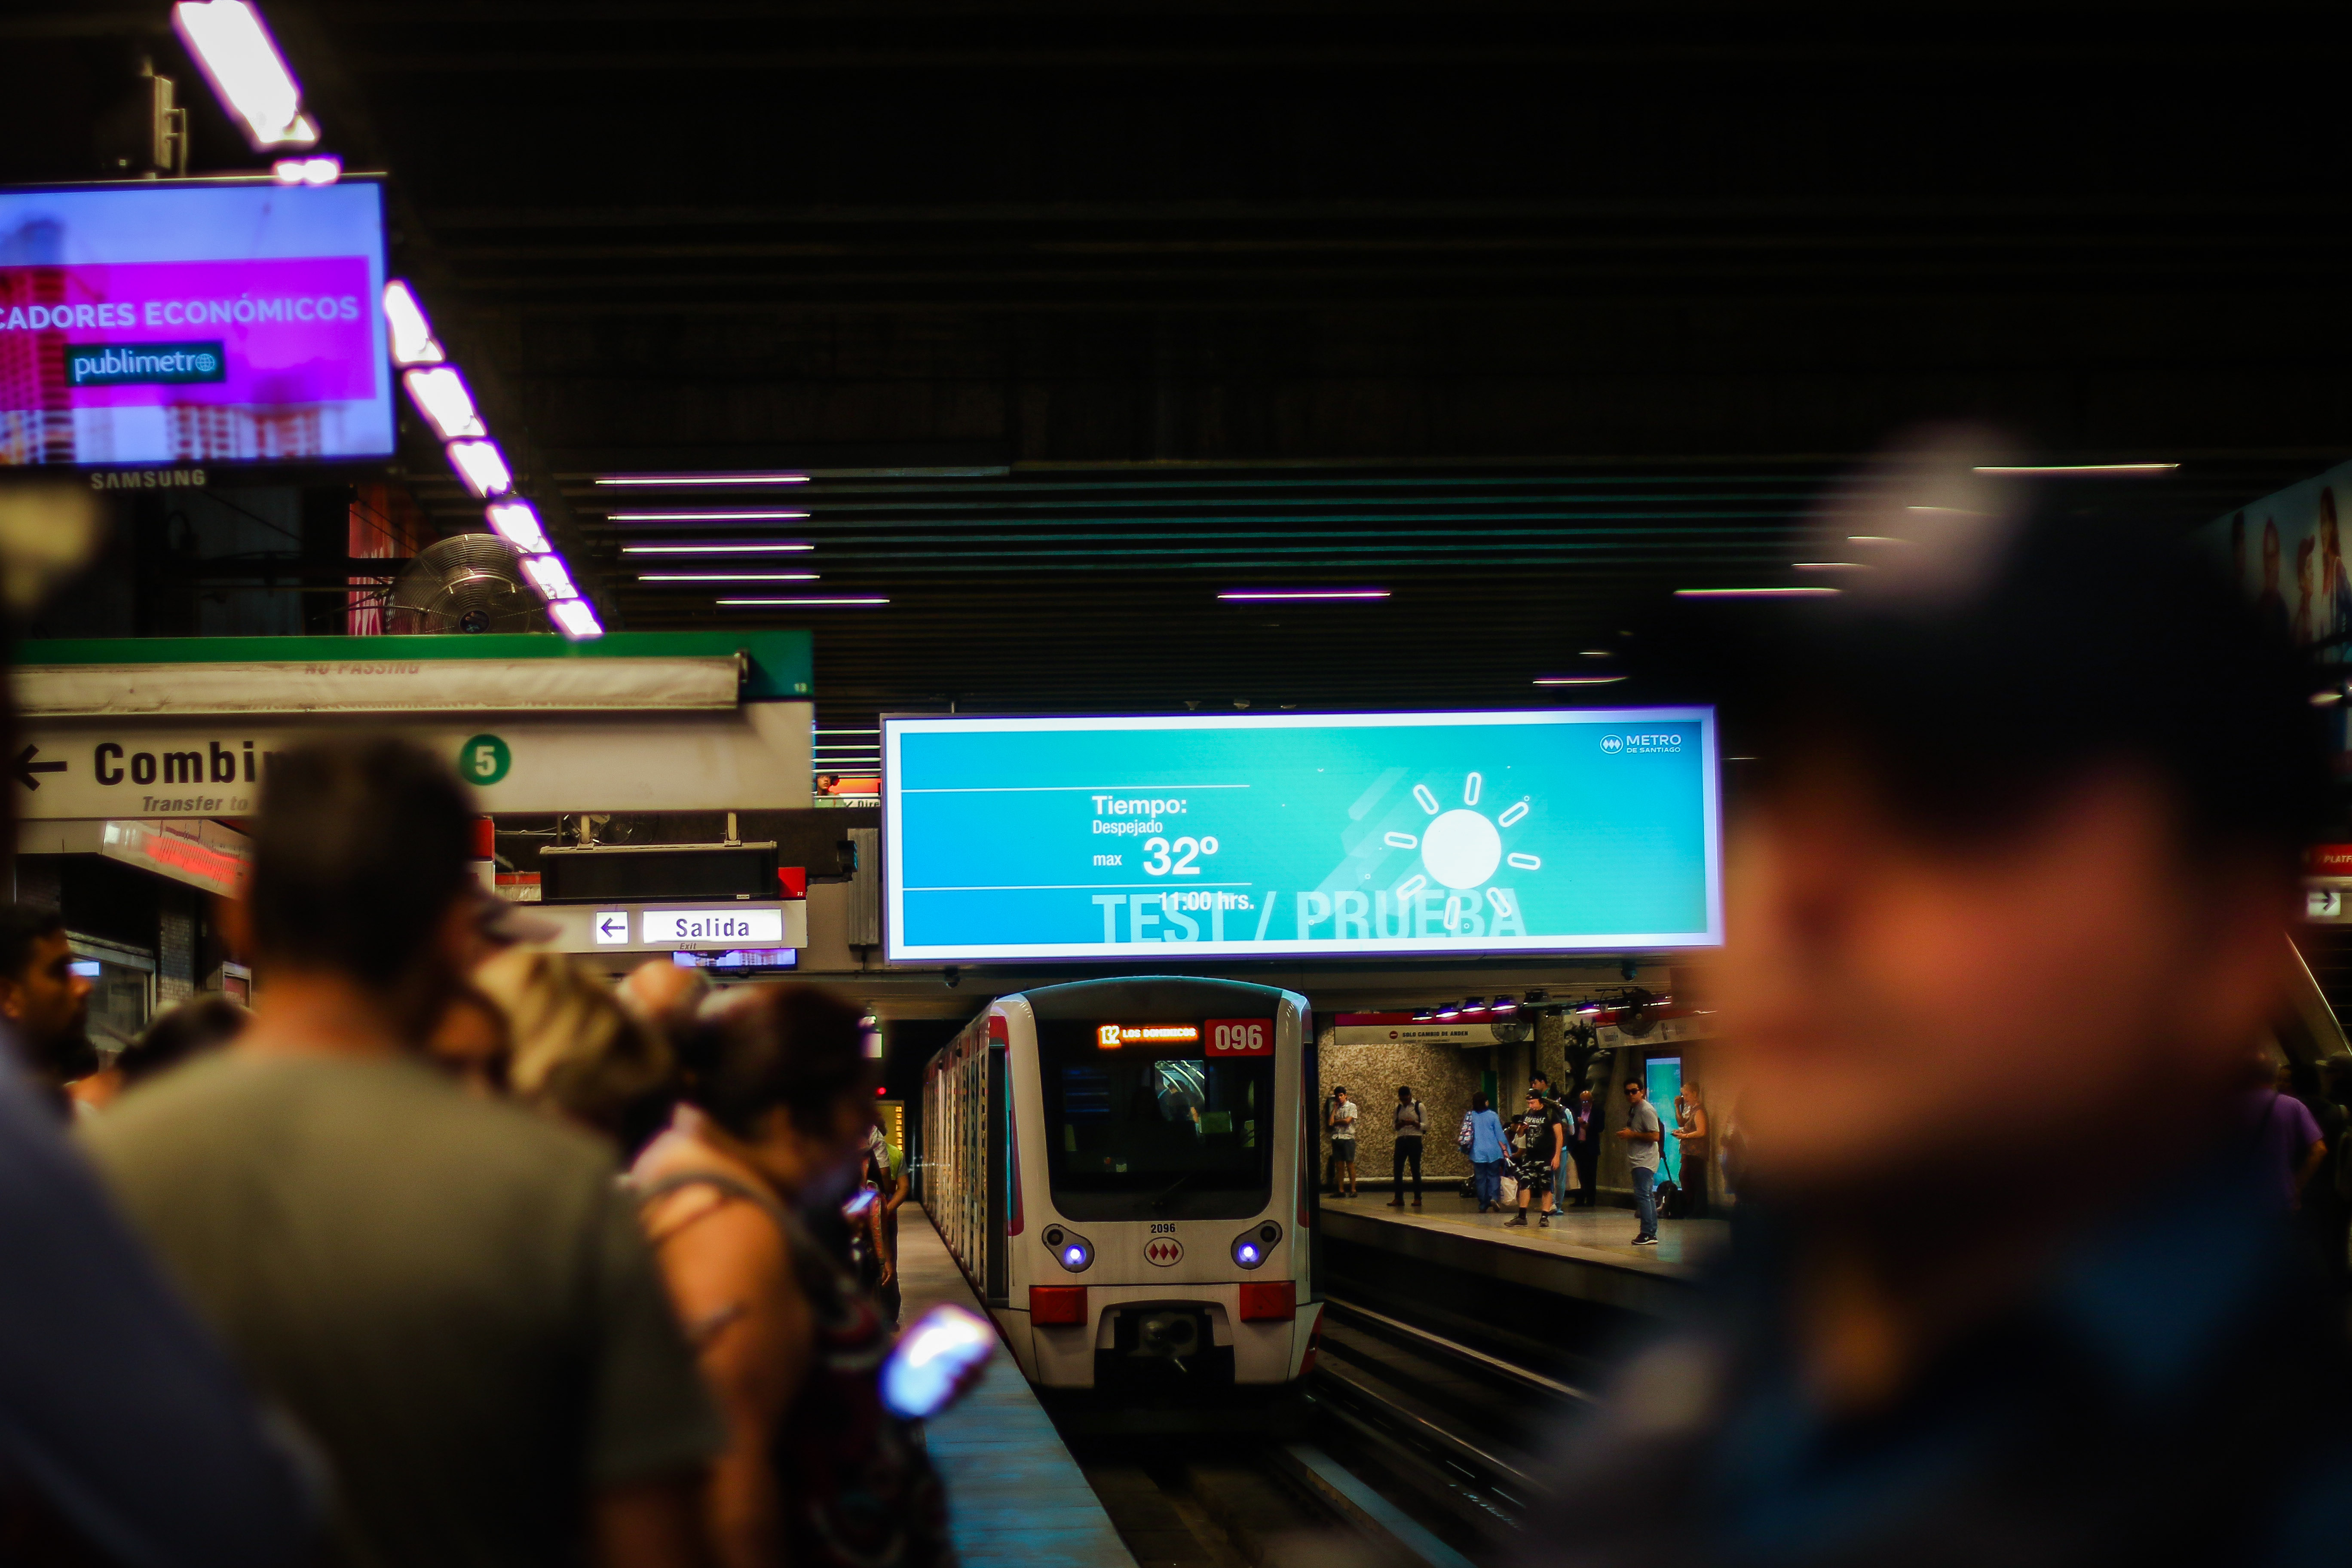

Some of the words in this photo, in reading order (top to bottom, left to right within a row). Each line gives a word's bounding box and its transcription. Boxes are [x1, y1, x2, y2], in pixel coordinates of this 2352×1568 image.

[0, 303, 135, 330] ADORES
[145, 293, 358, 325] ECONÓMICOS
[91, 469, 205, 489] SAMSUNG
[1626, 734, 1681, 746] METRO
[475, 746, 496, 776] 5
[143, 796, 223, 812] Transfer
[230, 796, 248, 811] to
[1092, 795, 1187, 818] Tiempo:
[1093, 819, 1163, 836] Despejado
[1093, 854, 1122, 866] max
[1159, 892, 1212, 911] 11:00
[1218, 891, 1255, 910] hrs.
[1092, 892, 1234, 943] TEST
[1296, 887, 1528, 940] PRUEBA
[676, 918, 749, 937] Salida
[1122, 1029, 1141, 1038] LOS
[1215, 1025, 1263, 1050] 096
[1150, 1223, 1176, 1234] 2096
